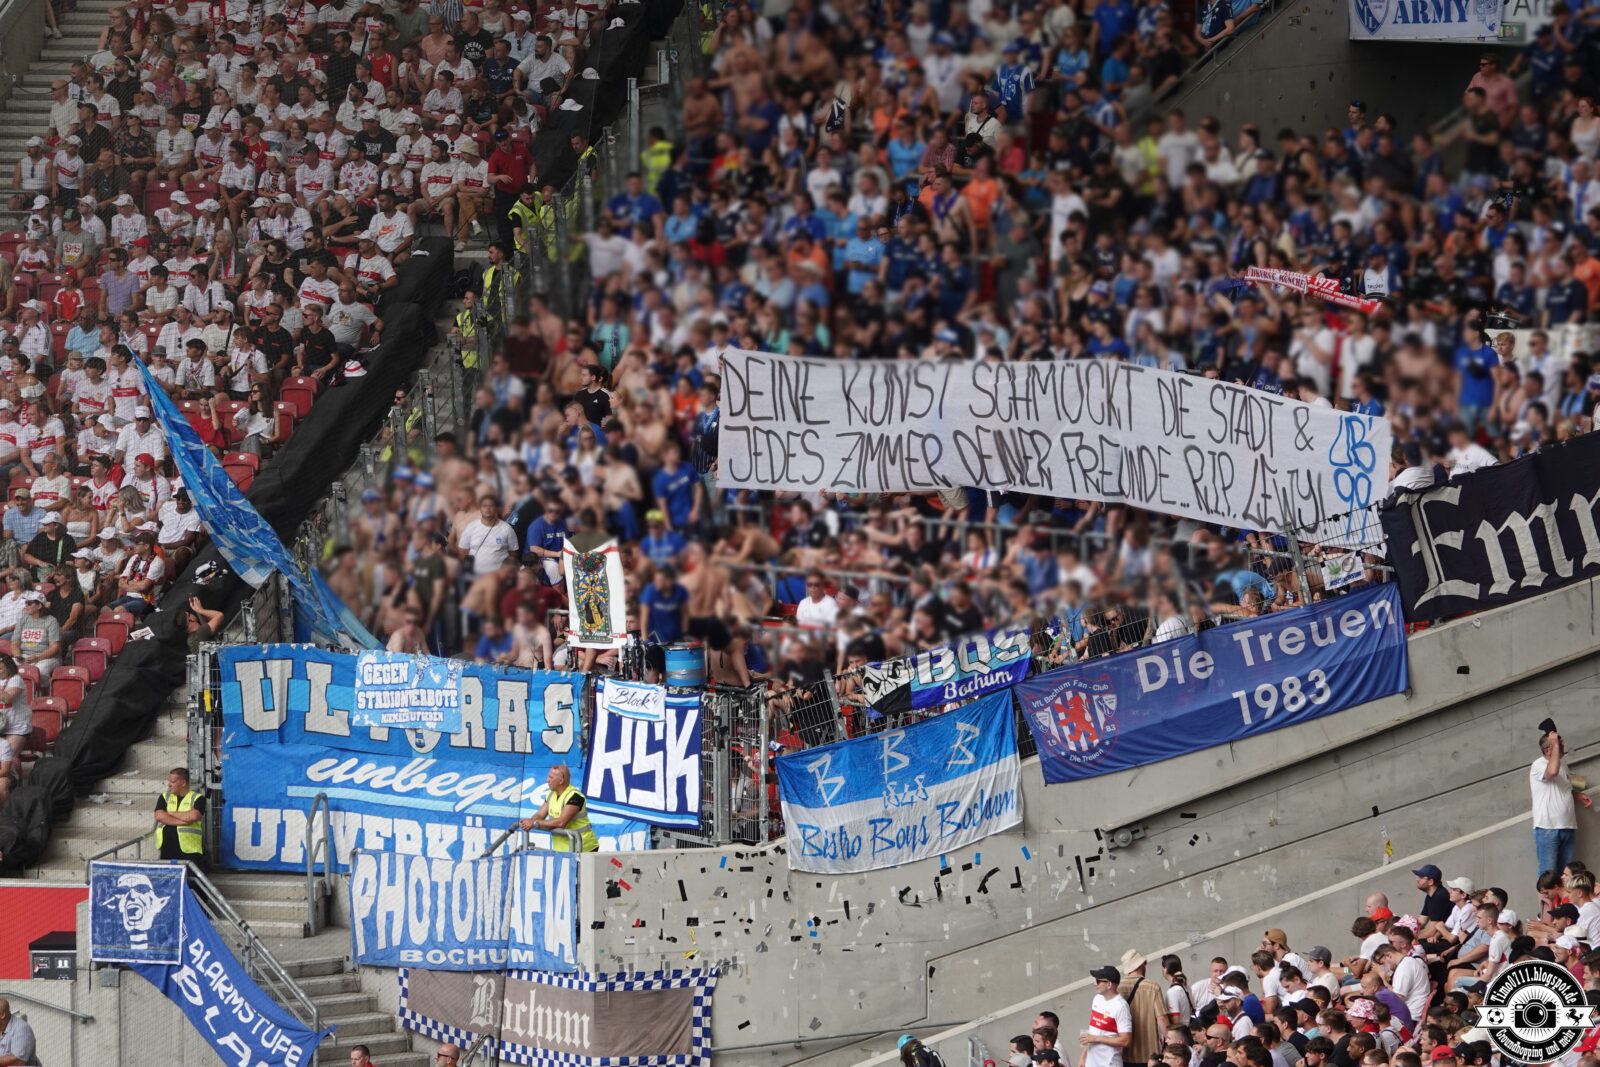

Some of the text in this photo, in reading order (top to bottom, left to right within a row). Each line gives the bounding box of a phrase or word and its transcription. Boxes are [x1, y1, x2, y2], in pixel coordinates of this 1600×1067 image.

[1392, 0, 1470, 24] ARMY
[723, 354, 1314, 458] DEINE KUNST SCHMÜCKT DIE STADT &
[724, 425, 825, 486] JEDES
[831, 431, 953, 492] ZIMMER
[952, 425, 1053, 492] DEINER
[362, 662, 410, 686] GEGEN
[915, 628, 1031, 685] BQS
[1136, 599, 1396, 693] Die Treuen
[234, 657, 575, 754] ULRAS
[942, 668, 1013, 701] Bochum
[1031, 701, 1044, 709] VfL
[1043, 680, 1071, 704] Bochum
[1073, 680, 1088, 689] Fan
[1232, 668, 1333, 726] 1983
[1069, 748, 1104, 763] Die Treuen
[1105, 724, 1117, 733] 83
[306, 757, 550, 812] unbeque
[807, 721, 980, 808] B B B
[868, 816, 930, 861] Boys
[936, 787, 1016, 839] Bochum
[352, 852, 577, 965] PHOTOMAFIA
[400, 949, 535, 965] BOCHUM
[171, 964, 270, 1067] BLA
[188, 938, 303, 1067] ALARMSTUFE
